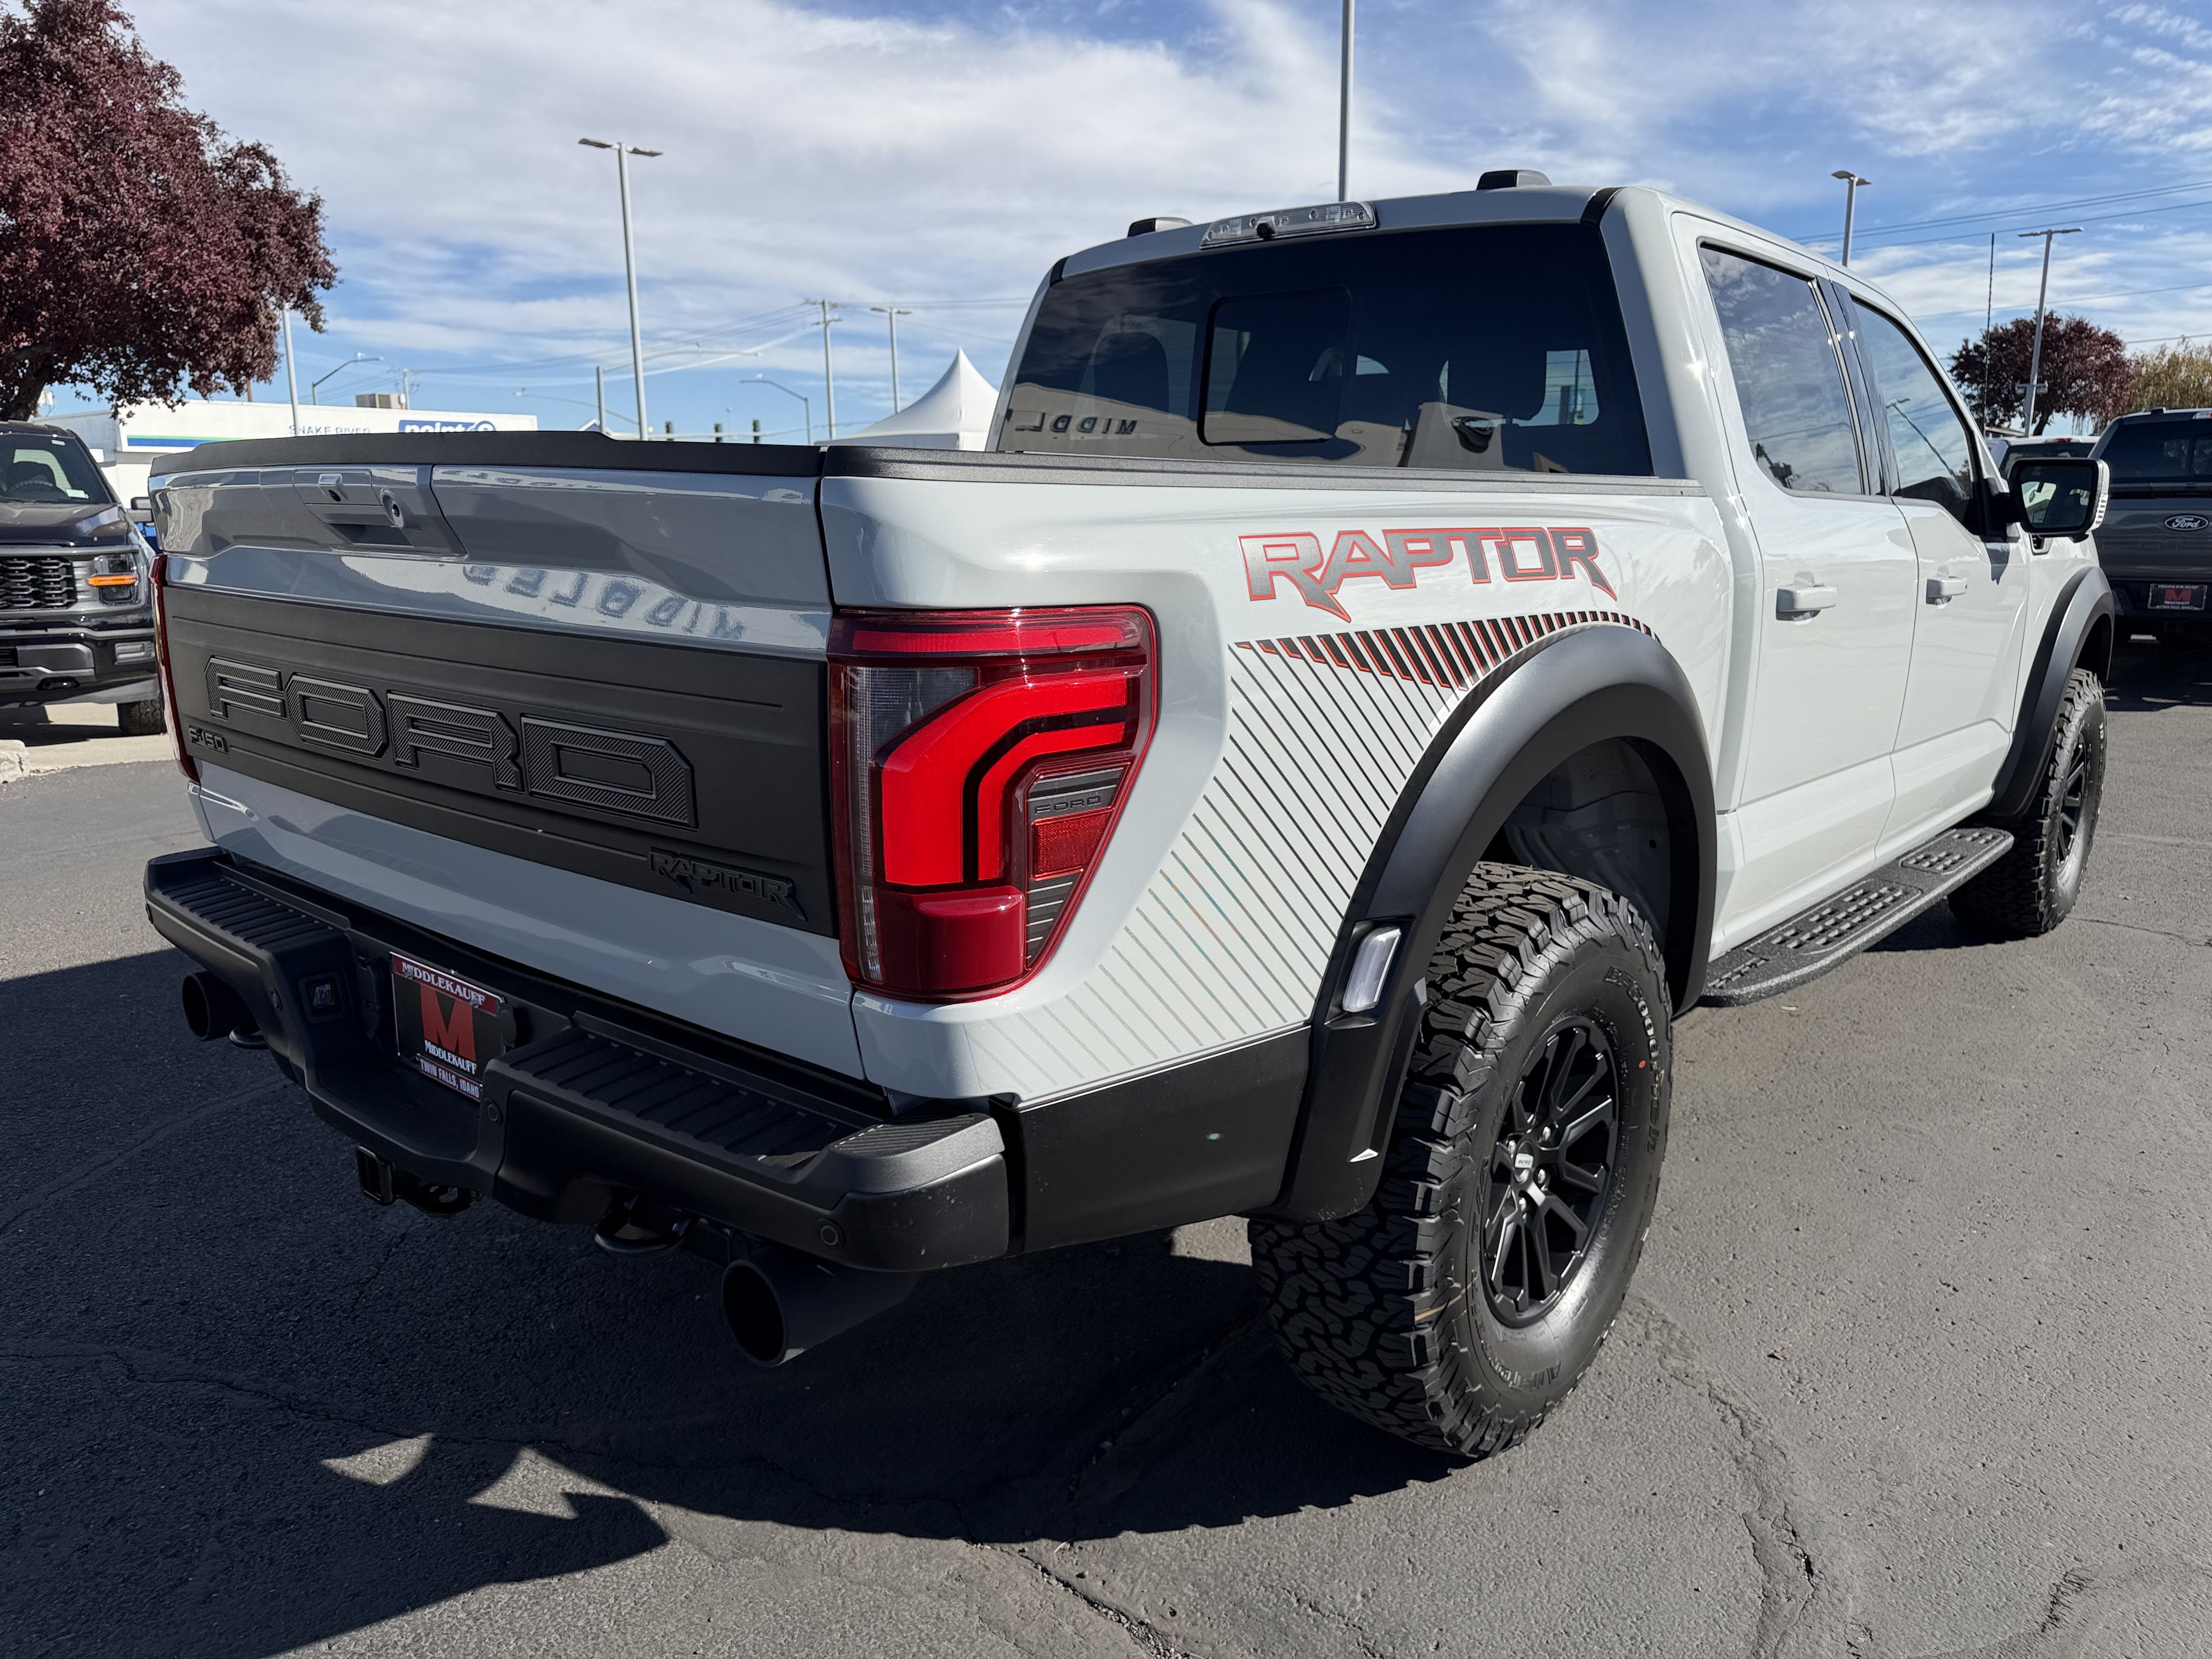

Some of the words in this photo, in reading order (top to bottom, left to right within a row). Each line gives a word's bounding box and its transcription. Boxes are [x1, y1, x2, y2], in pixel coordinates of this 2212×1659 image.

[289, 425, 331, 435] SNAKE
[2171, 517, 2200, 528] Ford
[1238, 527, 1618, 623] RAPTOR
[204, 655, 699, 830] FORD
[1035, 796, 1101, 815] FORD
[649, 847, 809, 923] RAPTOR
[420, 983, 477, 1063] M
[425, 1040, 477, 1075] MIDDLEKAUFF
[420, 1058, 437, 1077] TWIN
[438, 1065, 459, 1089] FALLS,
[460, 1079, 479, 1098] IDAHO
